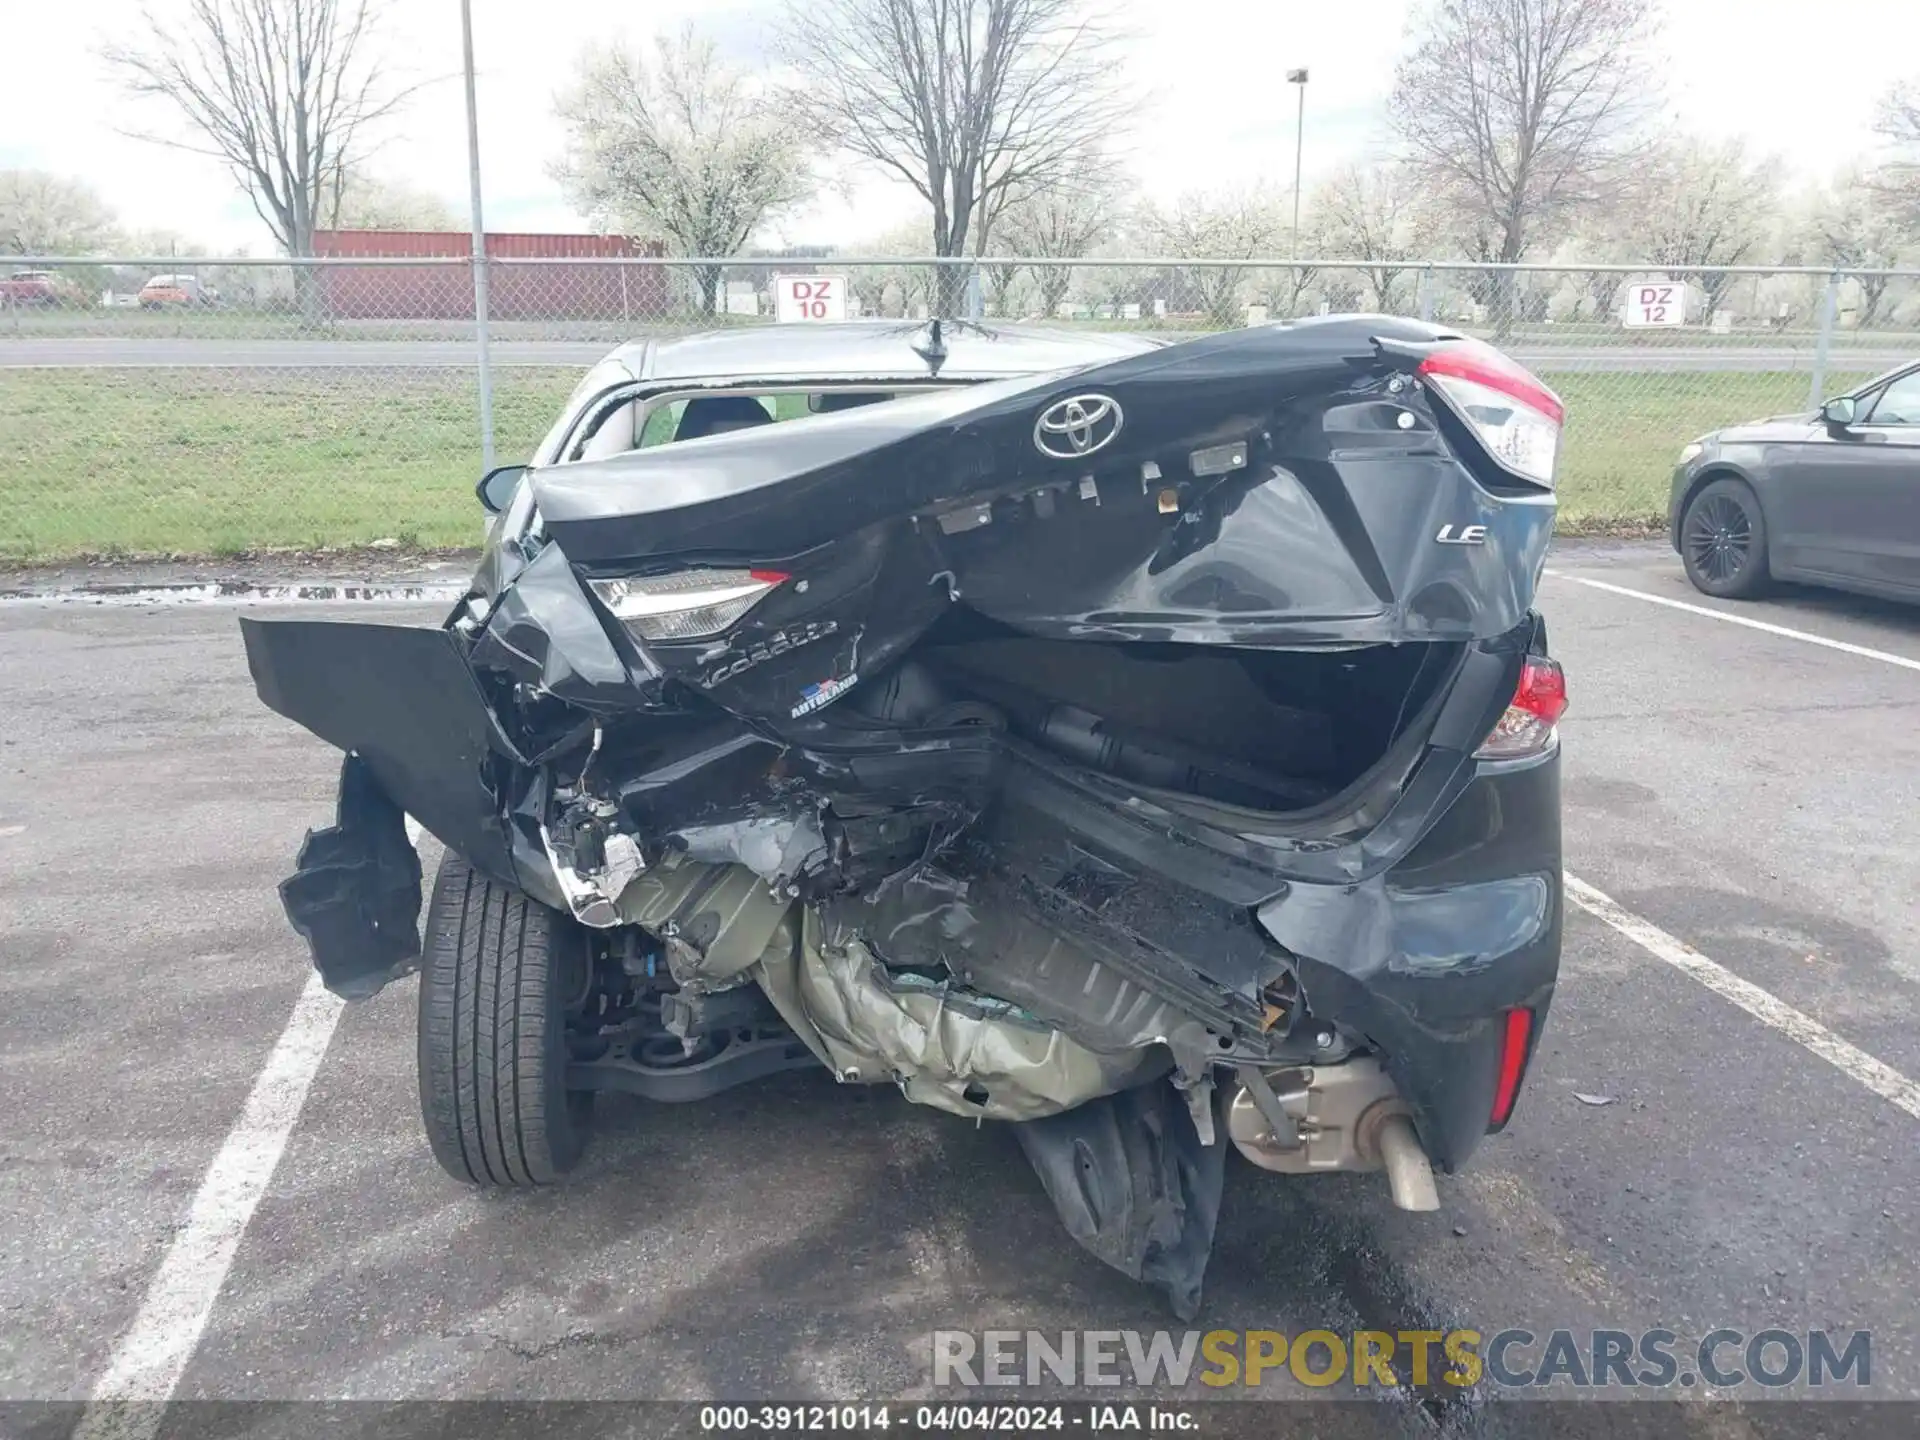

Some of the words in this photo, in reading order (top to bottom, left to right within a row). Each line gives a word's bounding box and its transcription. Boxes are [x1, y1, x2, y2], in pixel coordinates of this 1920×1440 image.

[792, 281, 831, 299] DZ
[1640, 287, 1673, 304] DZ
[798, 300, 826, 318] 10
[1643, 306, 1666, 322] 12
[1436, 524, 1488, 545] LE
